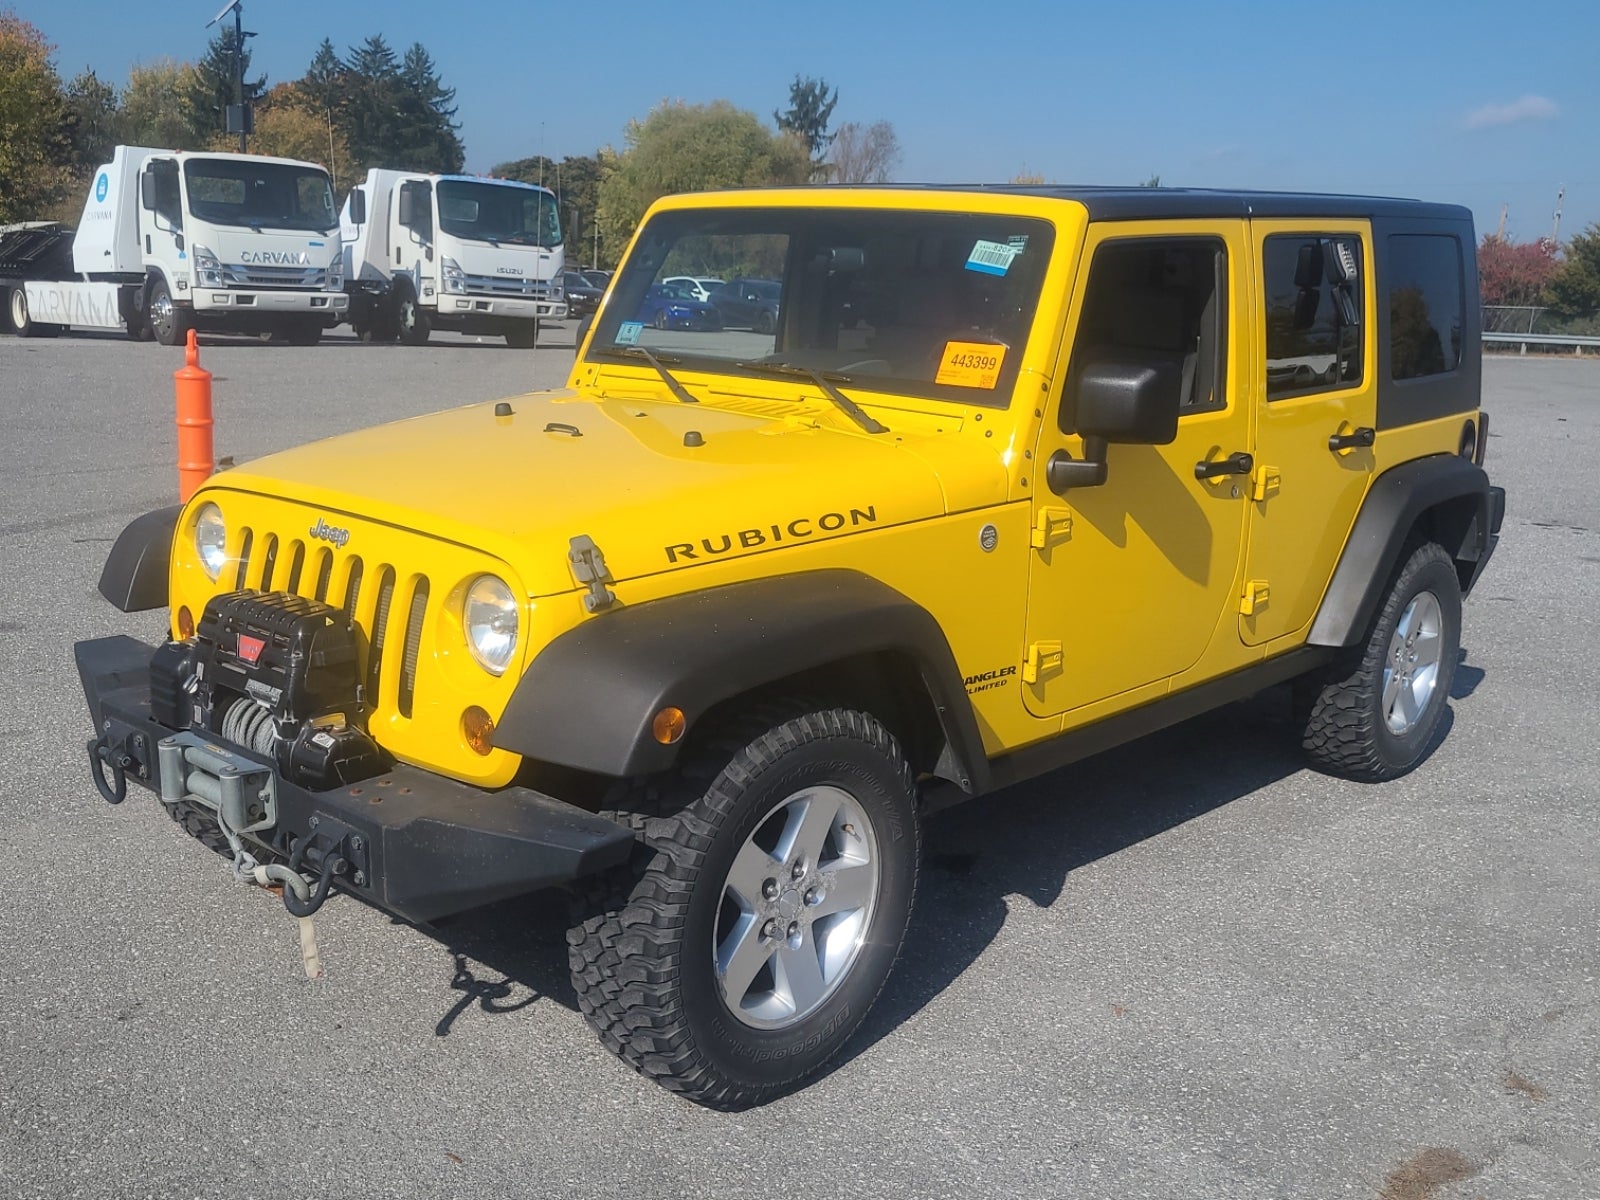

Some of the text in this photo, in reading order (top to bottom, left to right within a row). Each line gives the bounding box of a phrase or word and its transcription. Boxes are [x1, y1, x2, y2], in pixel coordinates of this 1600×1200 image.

[240, 251, 311, 265] CARVANA
[496, 266, 523, 275] ISUZU
[950, 353, 997, 370] 443399
[310, 518, 349, 549] Jeep
[664, 505, 877, 563] RUBICON
[963, 665, 1017, 685] ANGLER
[966, 679, 1008, 695] LIMITED
